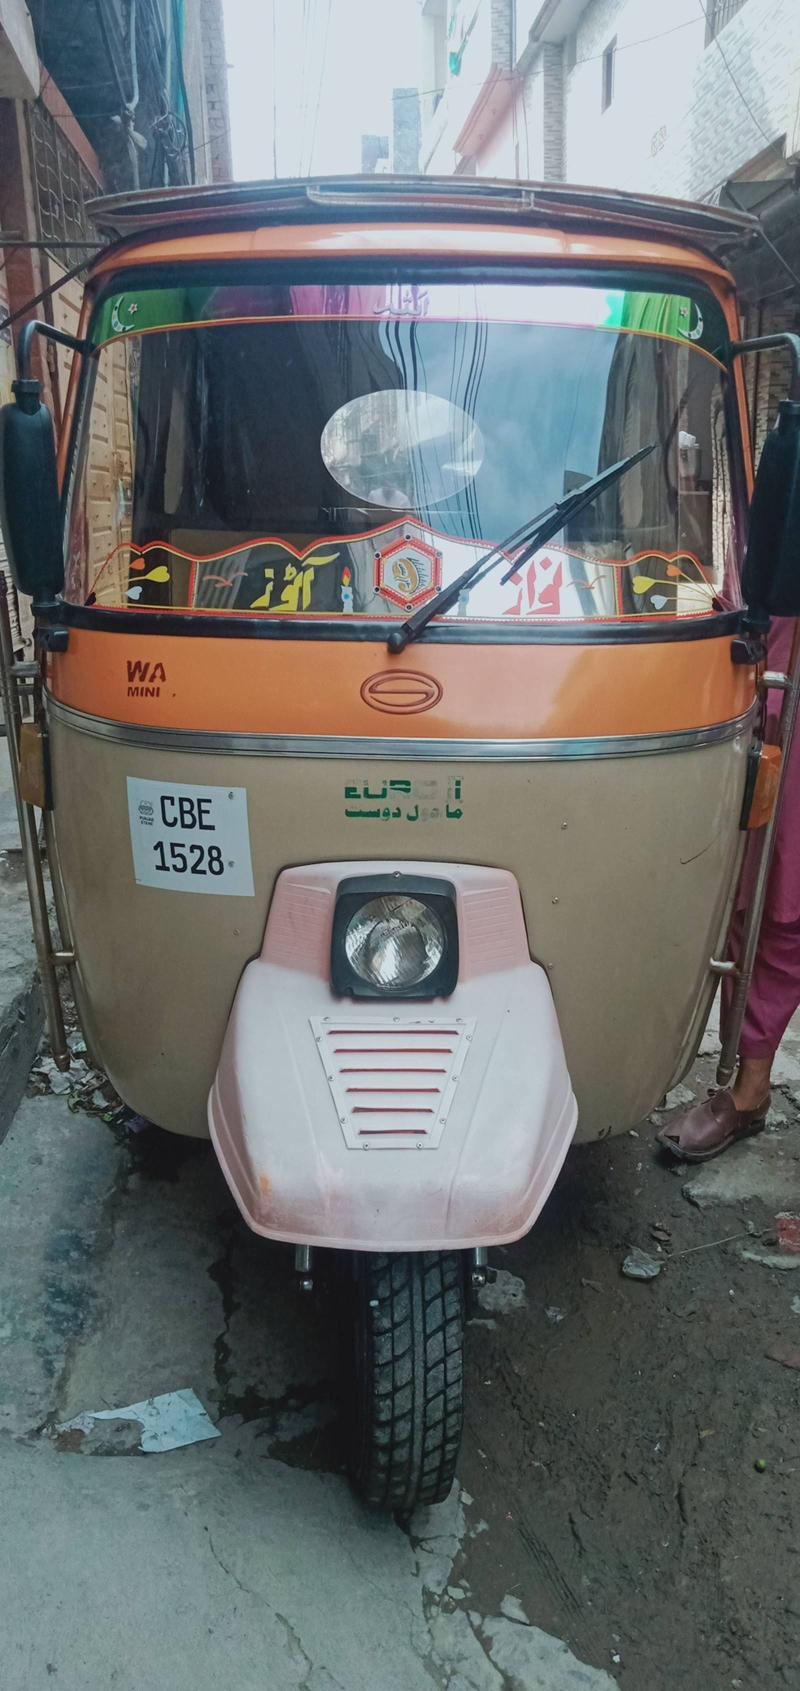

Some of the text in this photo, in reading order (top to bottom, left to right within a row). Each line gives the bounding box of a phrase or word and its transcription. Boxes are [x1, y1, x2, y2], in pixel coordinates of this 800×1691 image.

[127, 660, 166, 682] WA
[127, 687, 160, 697] MINI
[160, 795, 216, 831] CBE
[153, 841, 225, 876] 1528
